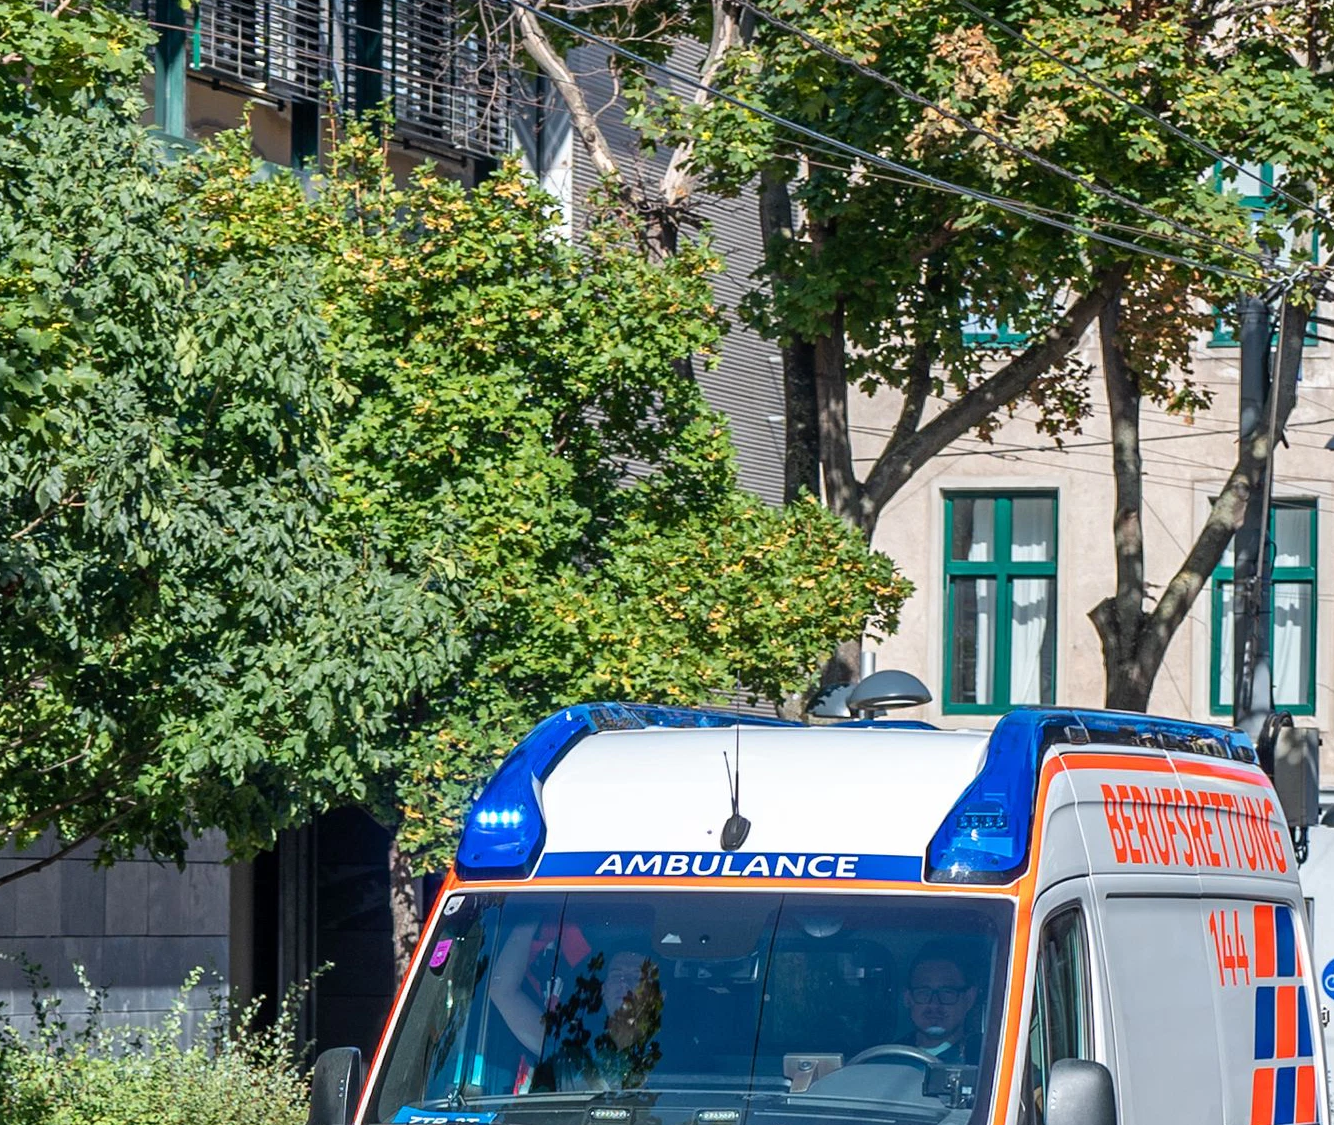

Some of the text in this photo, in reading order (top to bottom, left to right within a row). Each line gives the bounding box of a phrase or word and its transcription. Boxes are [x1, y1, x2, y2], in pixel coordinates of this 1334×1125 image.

[595, 854, 859, 878] AMBULANCE
[1100, 784, 1287, 873] BERUFSRETTUNG
[1209, 910, 1250, 986] 144
